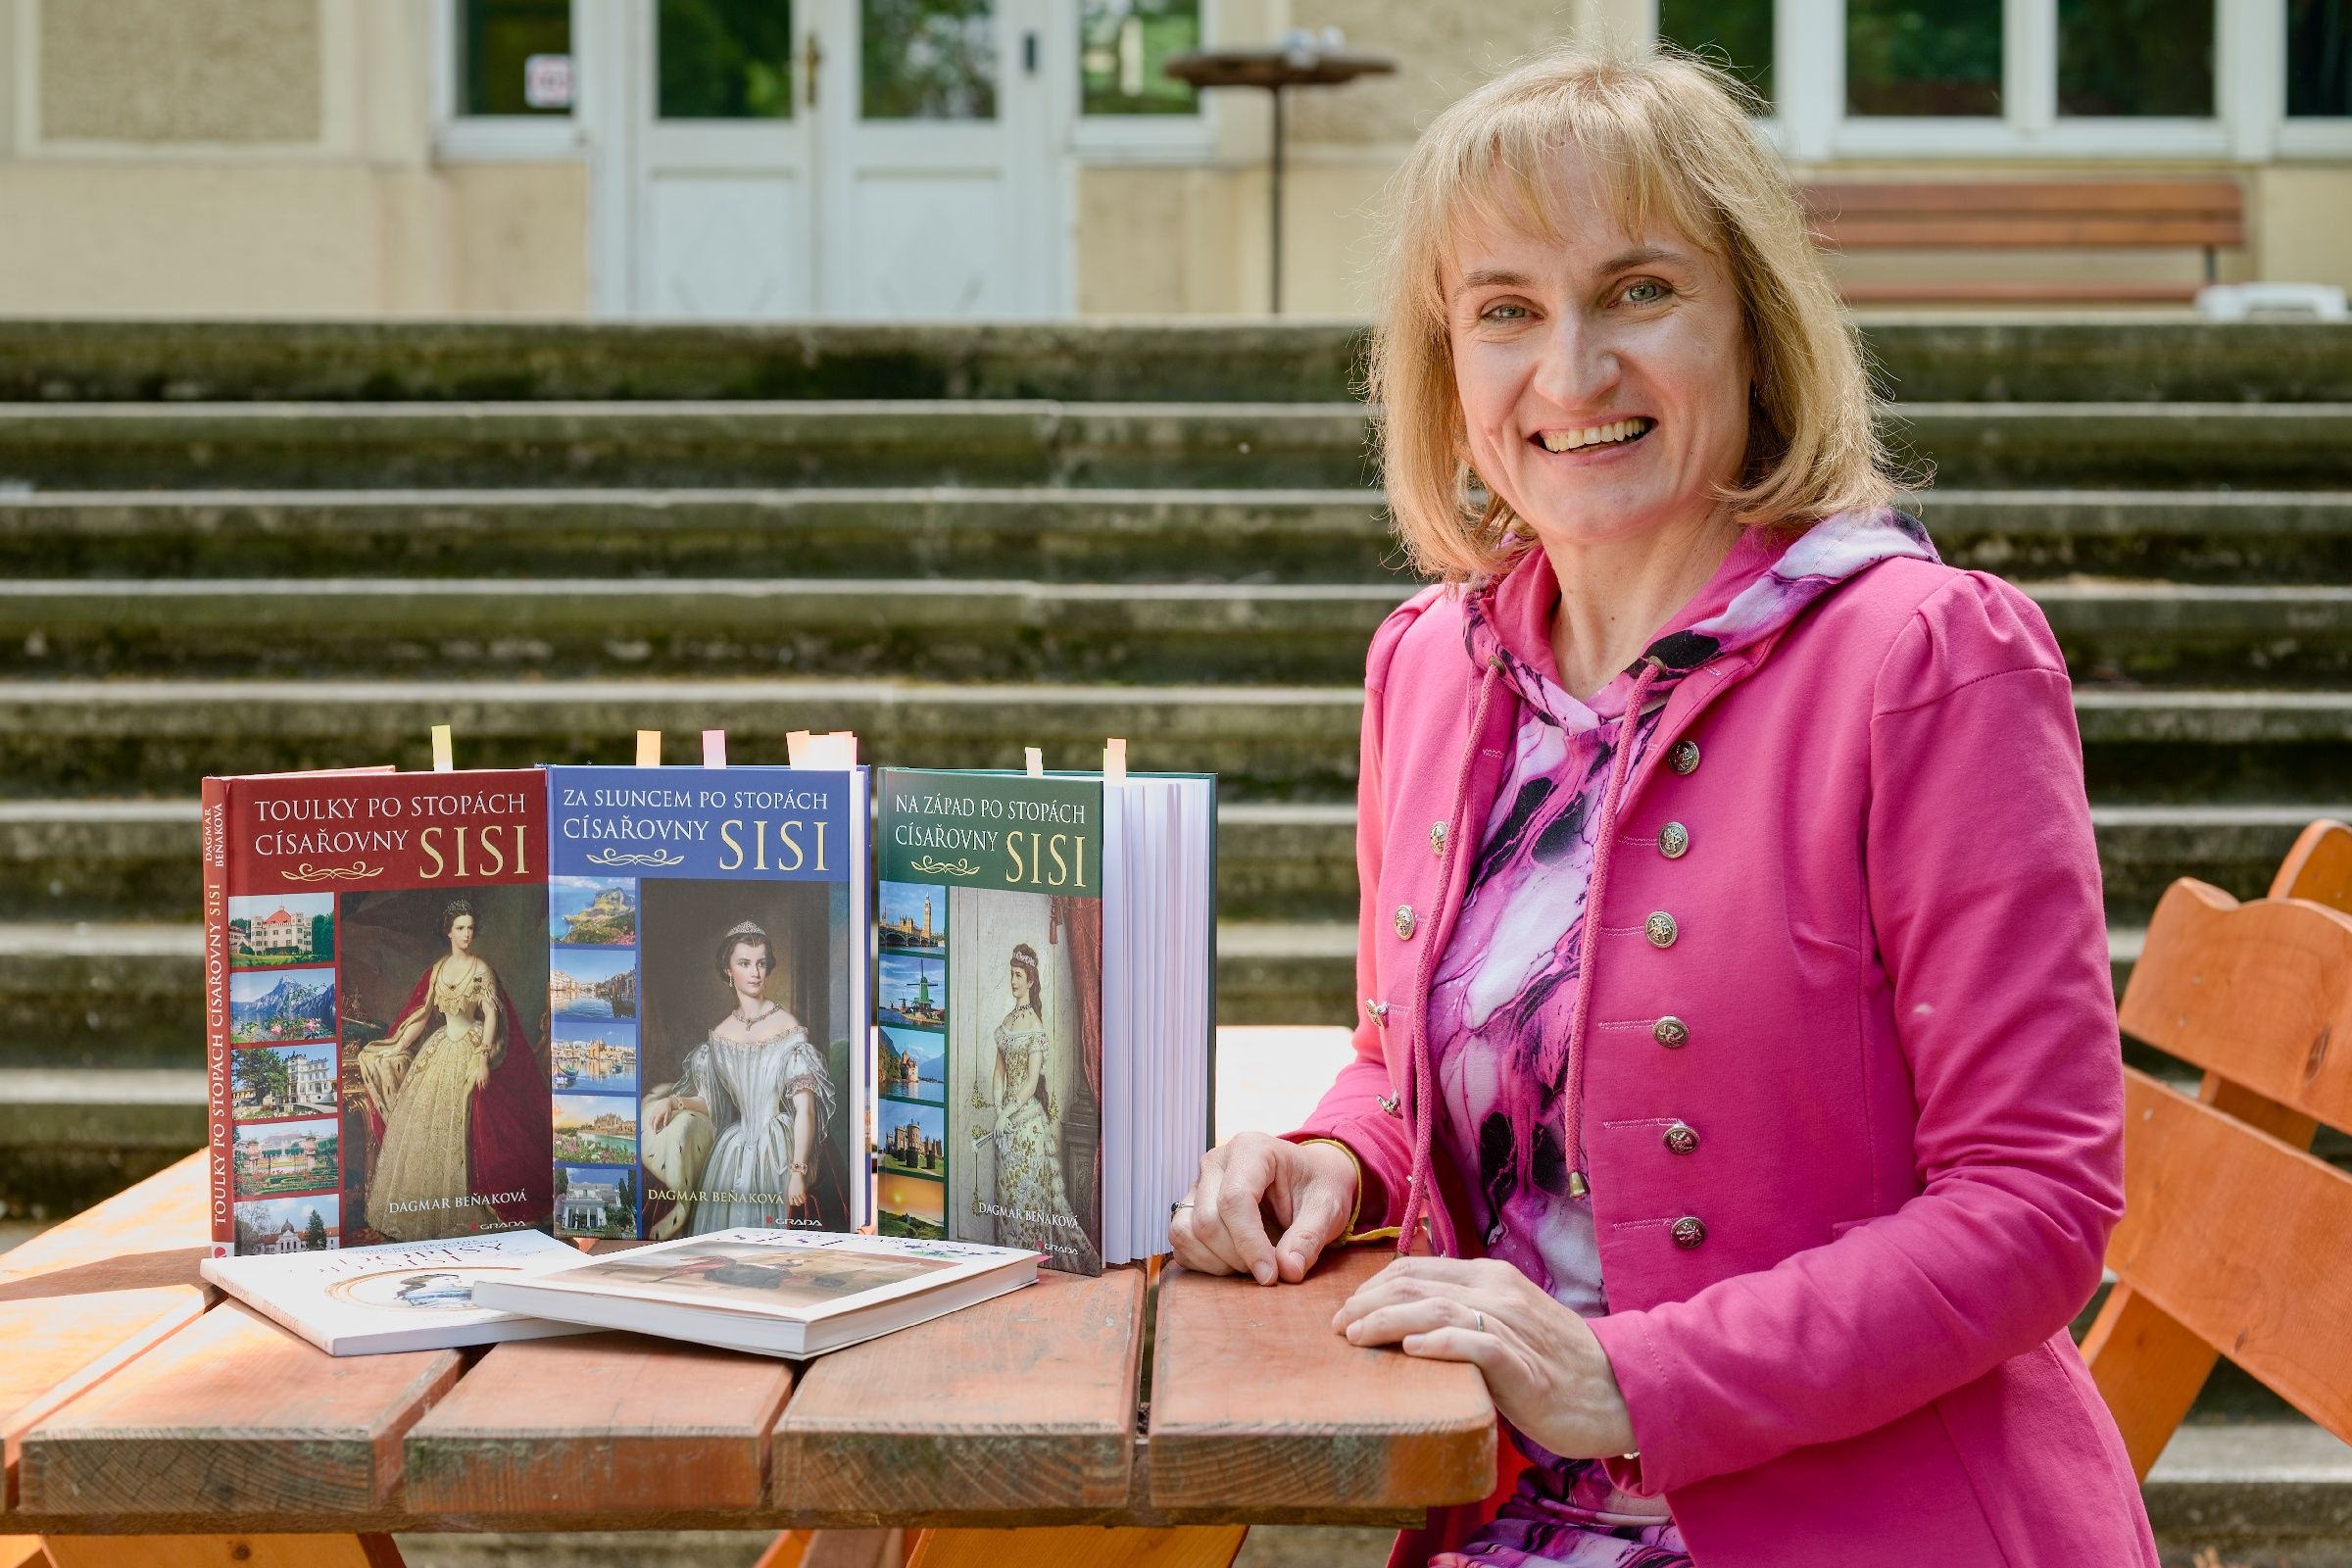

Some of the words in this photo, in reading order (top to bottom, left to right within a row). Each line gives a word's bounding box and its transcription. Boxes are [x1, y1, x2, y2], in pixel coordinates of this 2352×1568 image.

[254, 798, 359, 821] TOULKY
[368, 797, 402, 817] PO
[411, 790, 526, 816] STOPÁCH
[564, 790, 588, 807] ZA
[594, 790, 692, 808] SLUNCEM
[699, 791, 726, 808] PO
[734, 789, 828, 809] STOPÁCH
[895, 795, 918, 813] NA
[923, 793, 975, 817] ZÁPAD
[981, 799, 1003, 819] PO
[1007, 800, 1086, 824] STOPÁCH
[204, 808, 213, 862] DAGMAR
[213, 803, 224, 868] BEŇAKOVÁ
[564, 815, 710, 841] CÍSAŘOVNY
[719, 819, 830, 871] SISI
[254, 828, 410, 857] CÍSAŘOVNY
[419, 824, 530, 879] SISI
[895, 822, 999, 852] CÍSAŘOVNY
[1005, 831, 1087, 888] SISI
[209, 883, 220, 916] SISI
[209, 922, 223, 1027] CÍSAŘOVNY
[211, 1034, 224, 1117] STOPÁCH
[213, 1123, 225, 1148] PO
[214, 1153, 226, 1227] TOULKY
[389, 1199, 450, 1213] DAGMAR
[455, 1188, 527, 1207] BEŇAKOVÁ
[648, 1190, 708, 1201] DAGMAR
[712, 1189, 784, 1204] BEŇAKOVÁ
[480, 1220, 526, 1230] GRADA
[979, 1202, 1022, 1220] DAGMAR
[1026, 1209, 1079, 1228] BEŇAKOVÁ
[1044, 1243, 1079, 1255] GRADA
